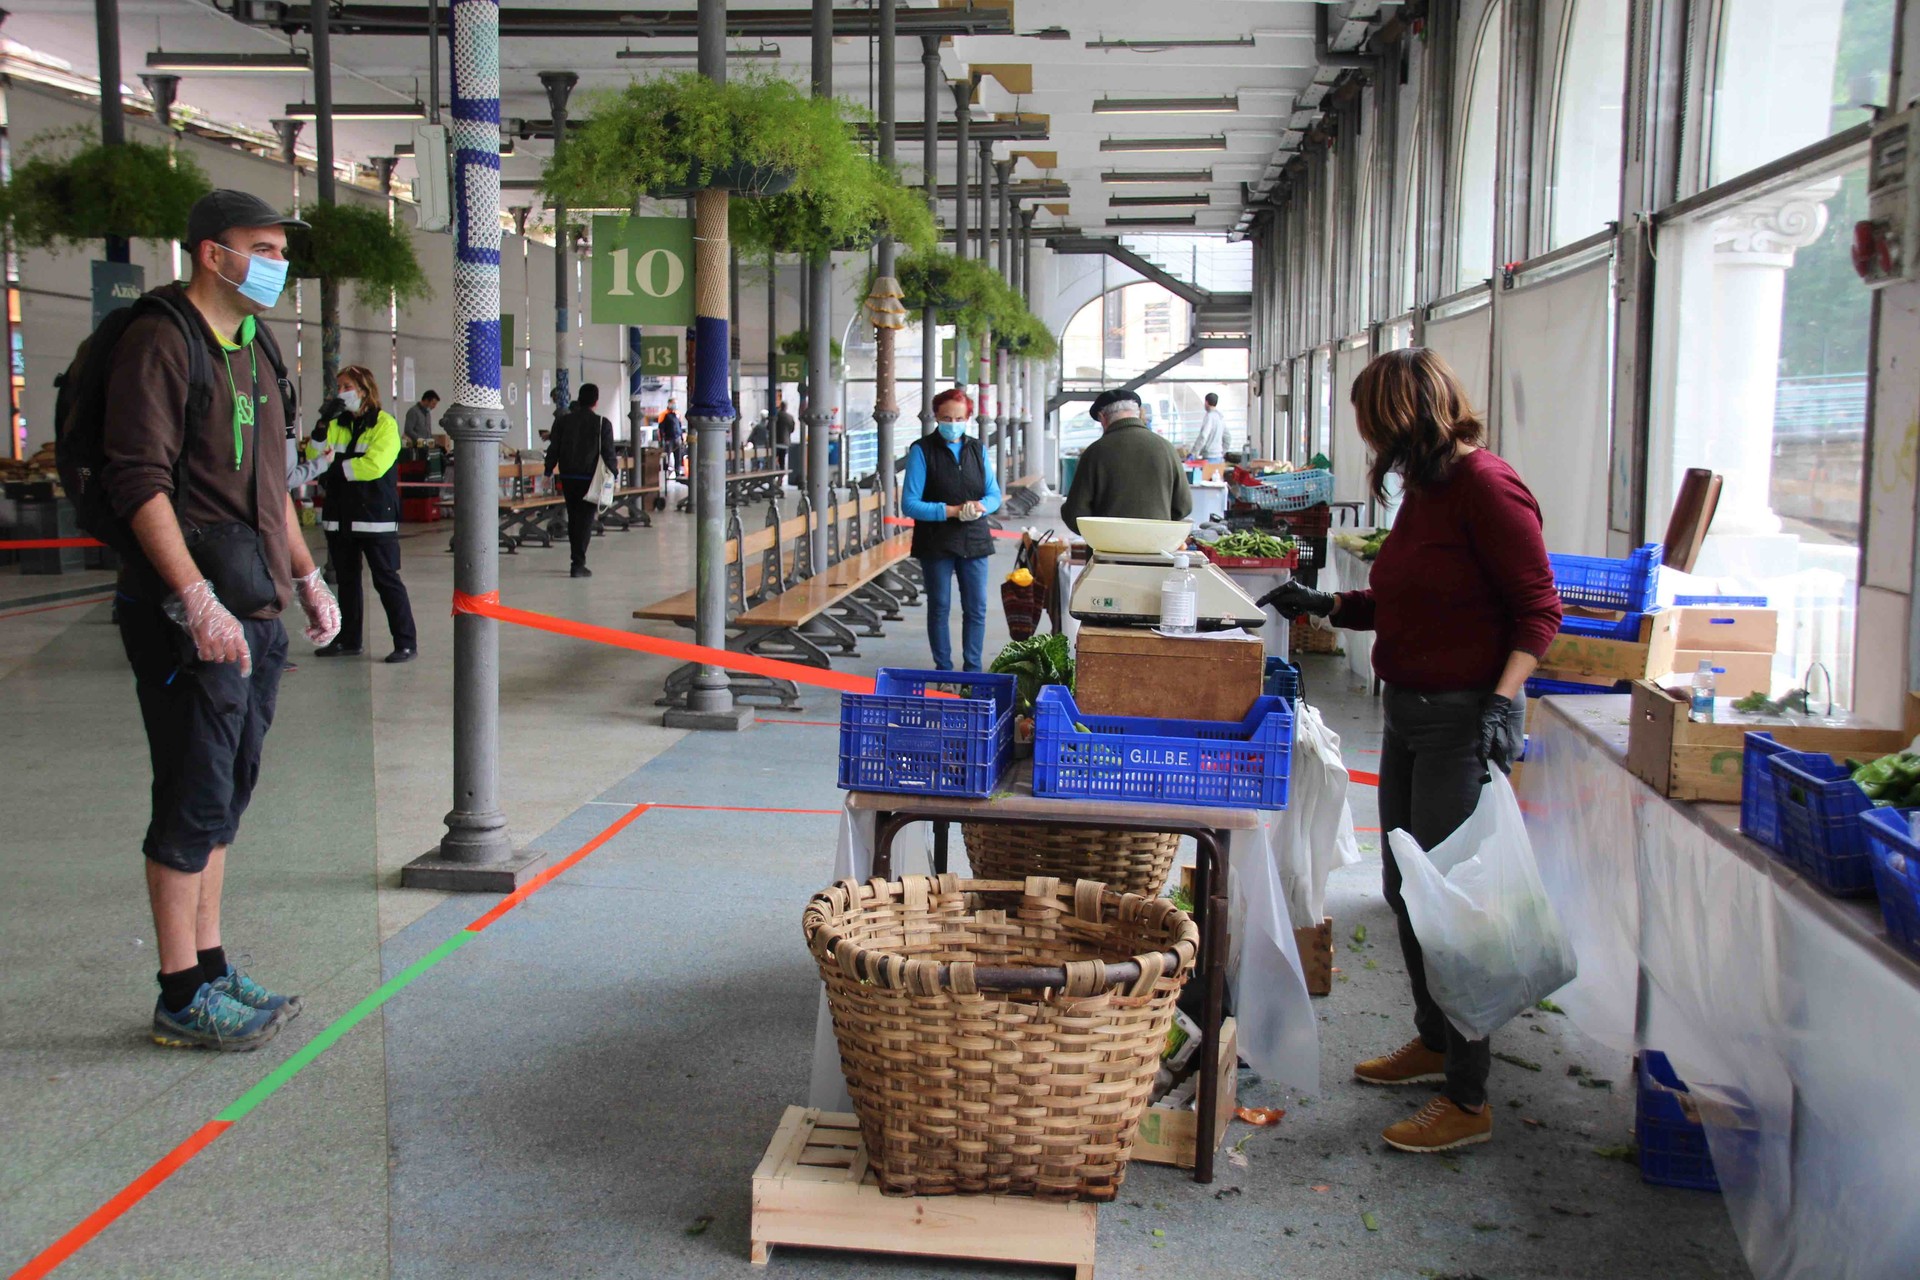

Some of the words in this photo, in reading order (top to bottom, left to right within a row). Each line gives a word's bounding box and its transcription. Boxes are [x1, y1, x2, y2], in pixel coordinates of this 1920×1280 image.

[607, 248, 685, 298] 10
[647, 347, 672, 367] 13
[780, 362, 799, 378] 15
[1130, 748, 1191, 766] G.I.L.B.E.
